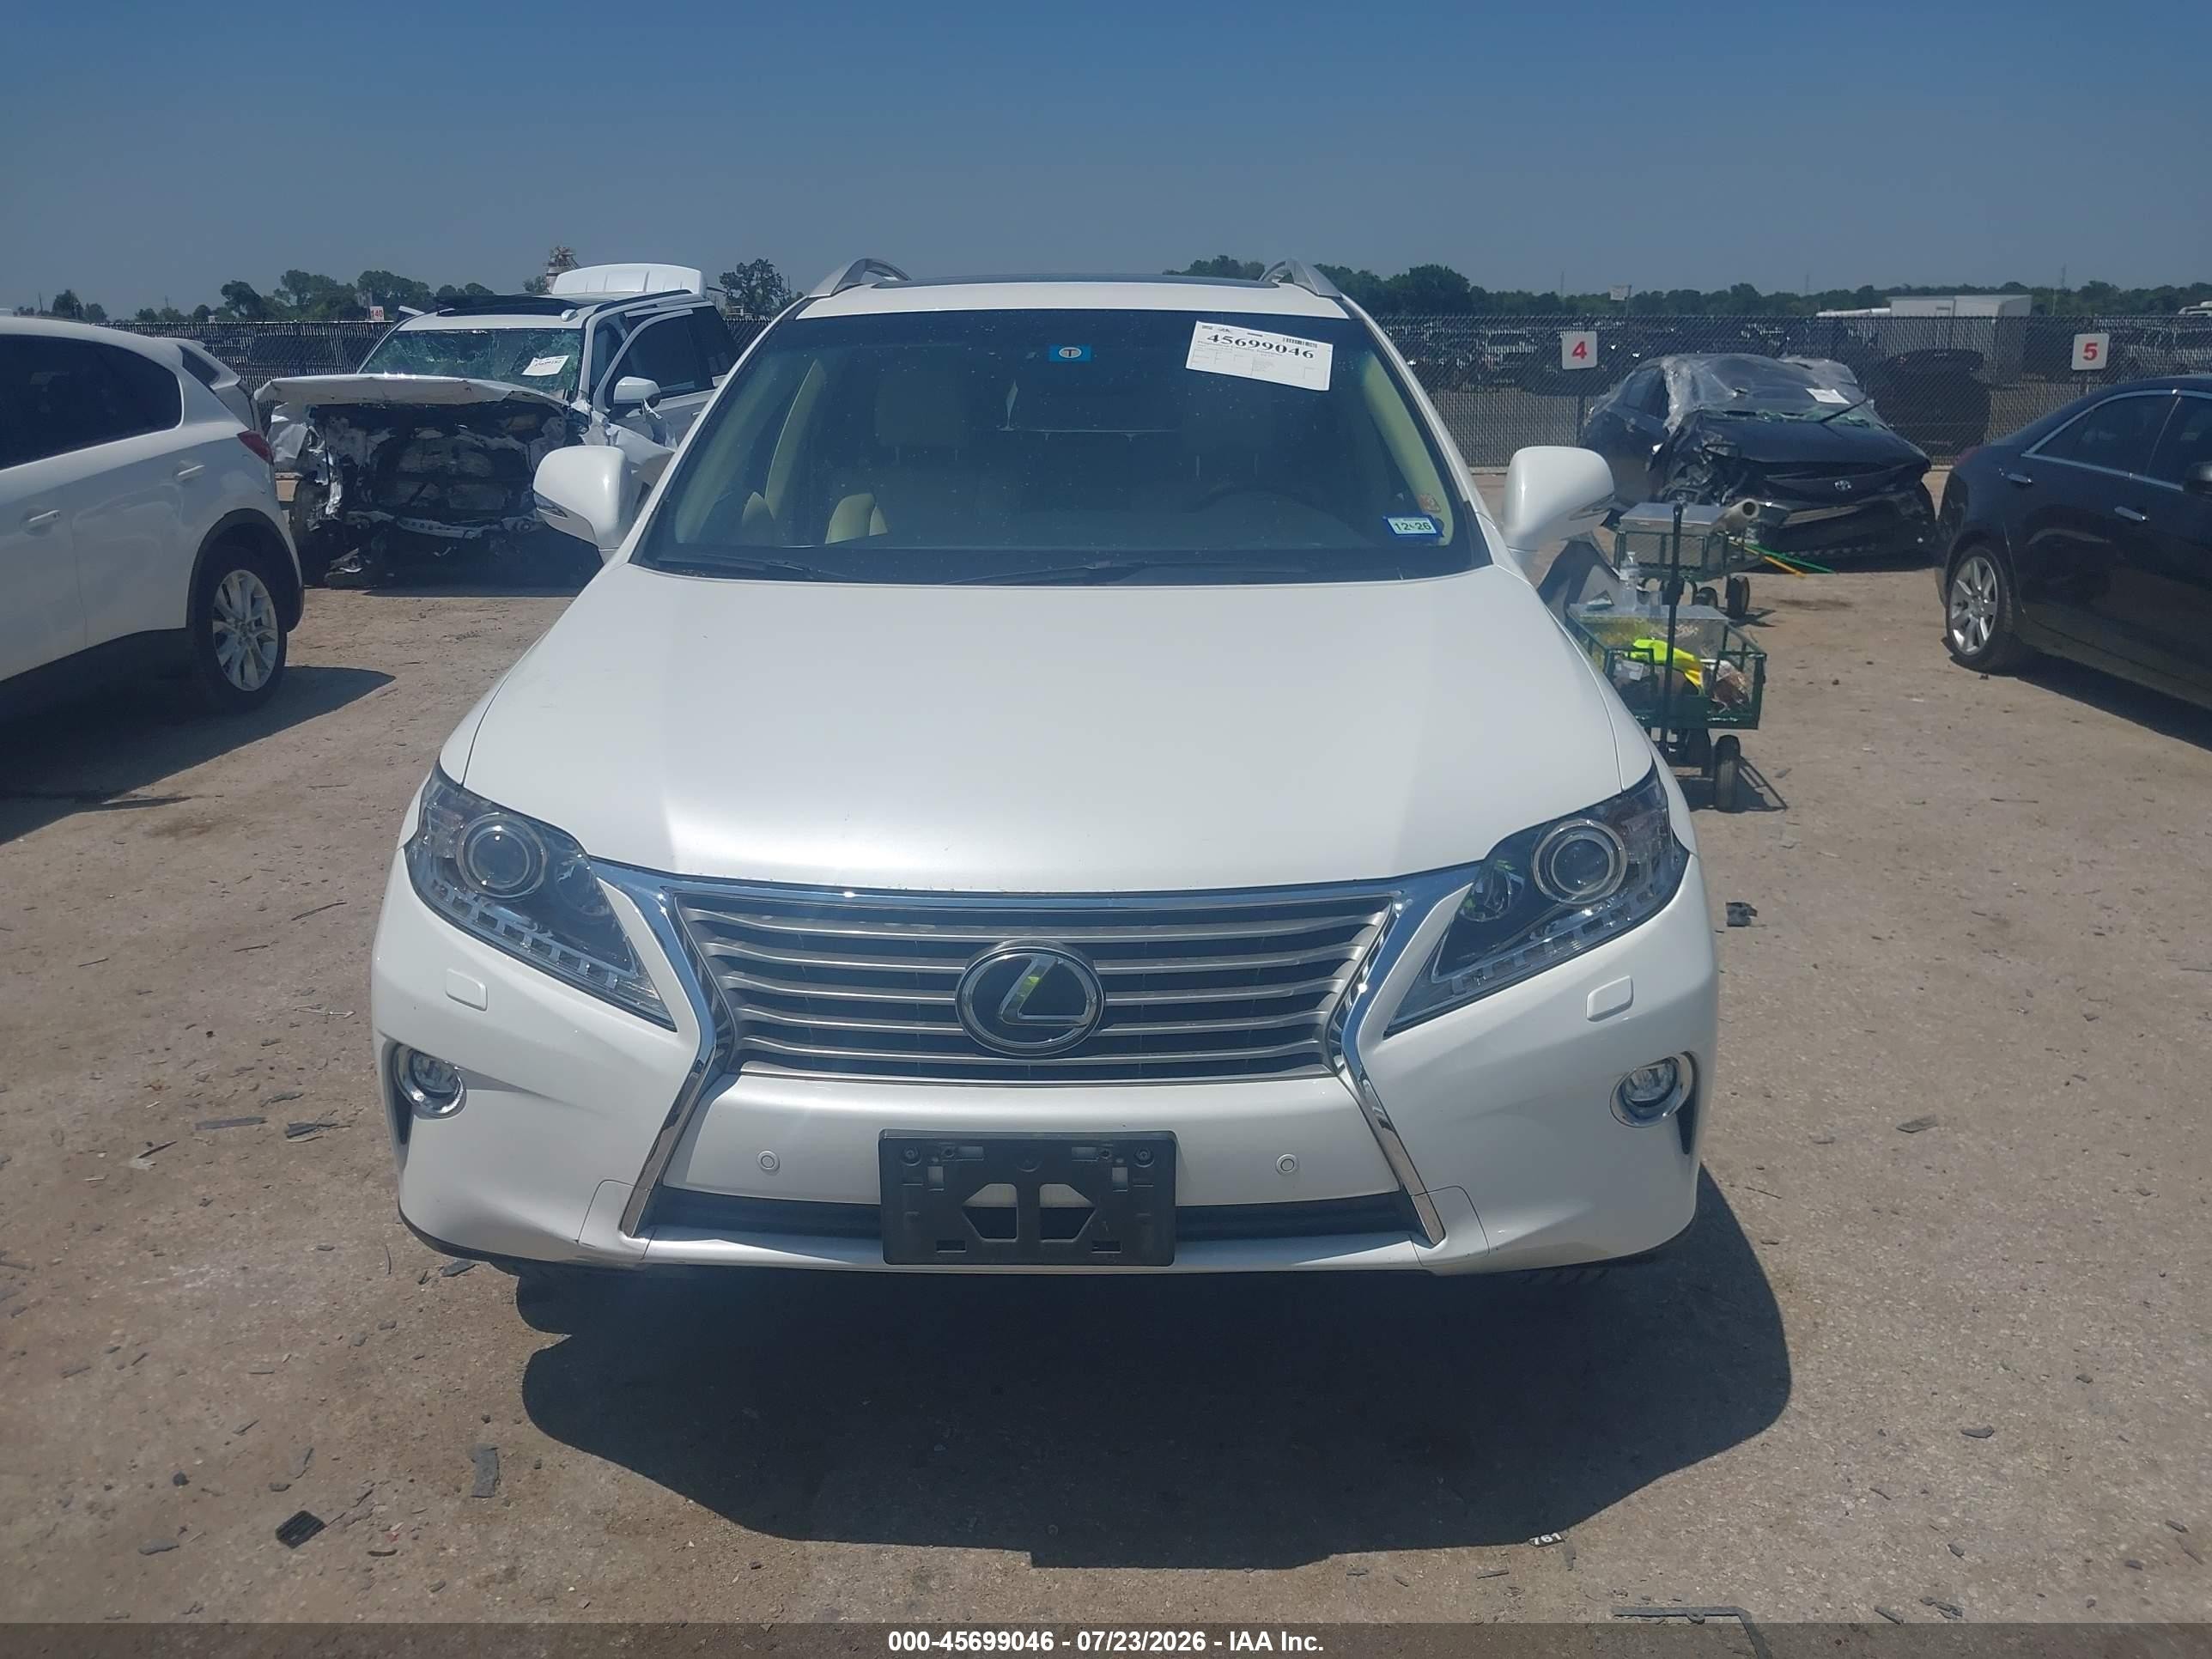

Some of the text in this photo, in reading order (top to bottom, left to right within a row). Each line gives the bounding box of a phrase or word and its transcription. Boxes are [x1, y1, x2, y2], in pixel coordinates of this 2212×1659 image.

[371, 309, 383, 318] 140
[1206, 333, 1315, 359] 45699046
[1572, 341, 1588, 360] 4
[2082, 343, 2099, 361] 5
